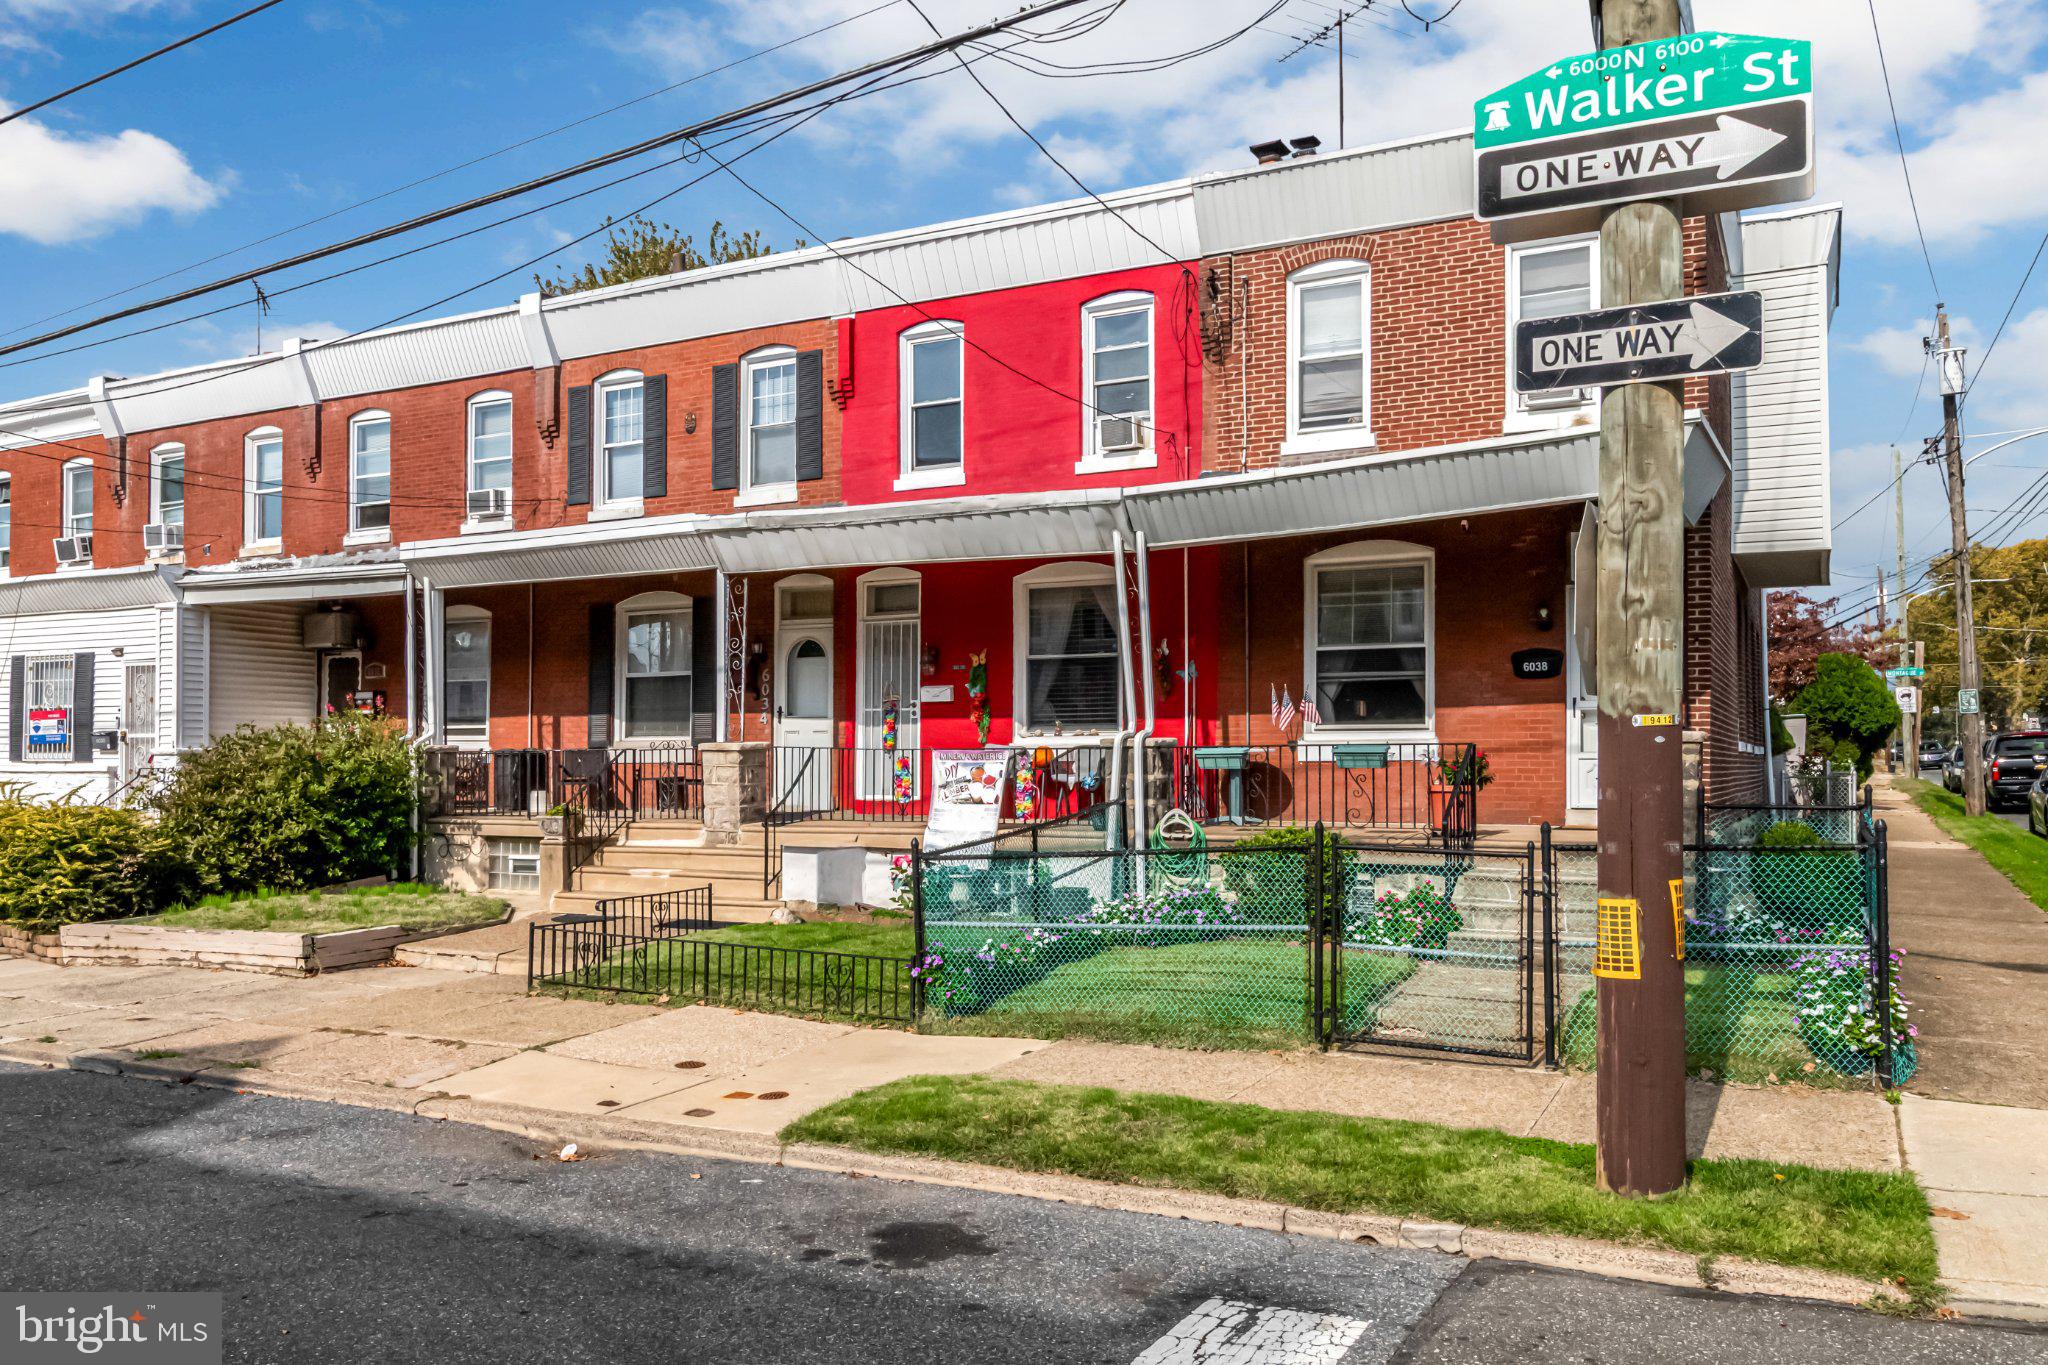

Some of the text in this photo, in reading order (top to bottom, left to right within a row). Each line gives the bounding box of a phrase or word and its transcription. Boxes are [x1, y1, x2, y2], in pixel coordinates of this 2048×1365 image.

[1655, 37, 1704, 60] 6100
[1525, 48, 1799, 130] Walker St
[1516, 136, 1705, 192] ONE WAY
[1540, 323, 1684, 367] ONE WAY
[1523, 661, 1548, 672] 6038
[970, 752, 994, 761] WATER
